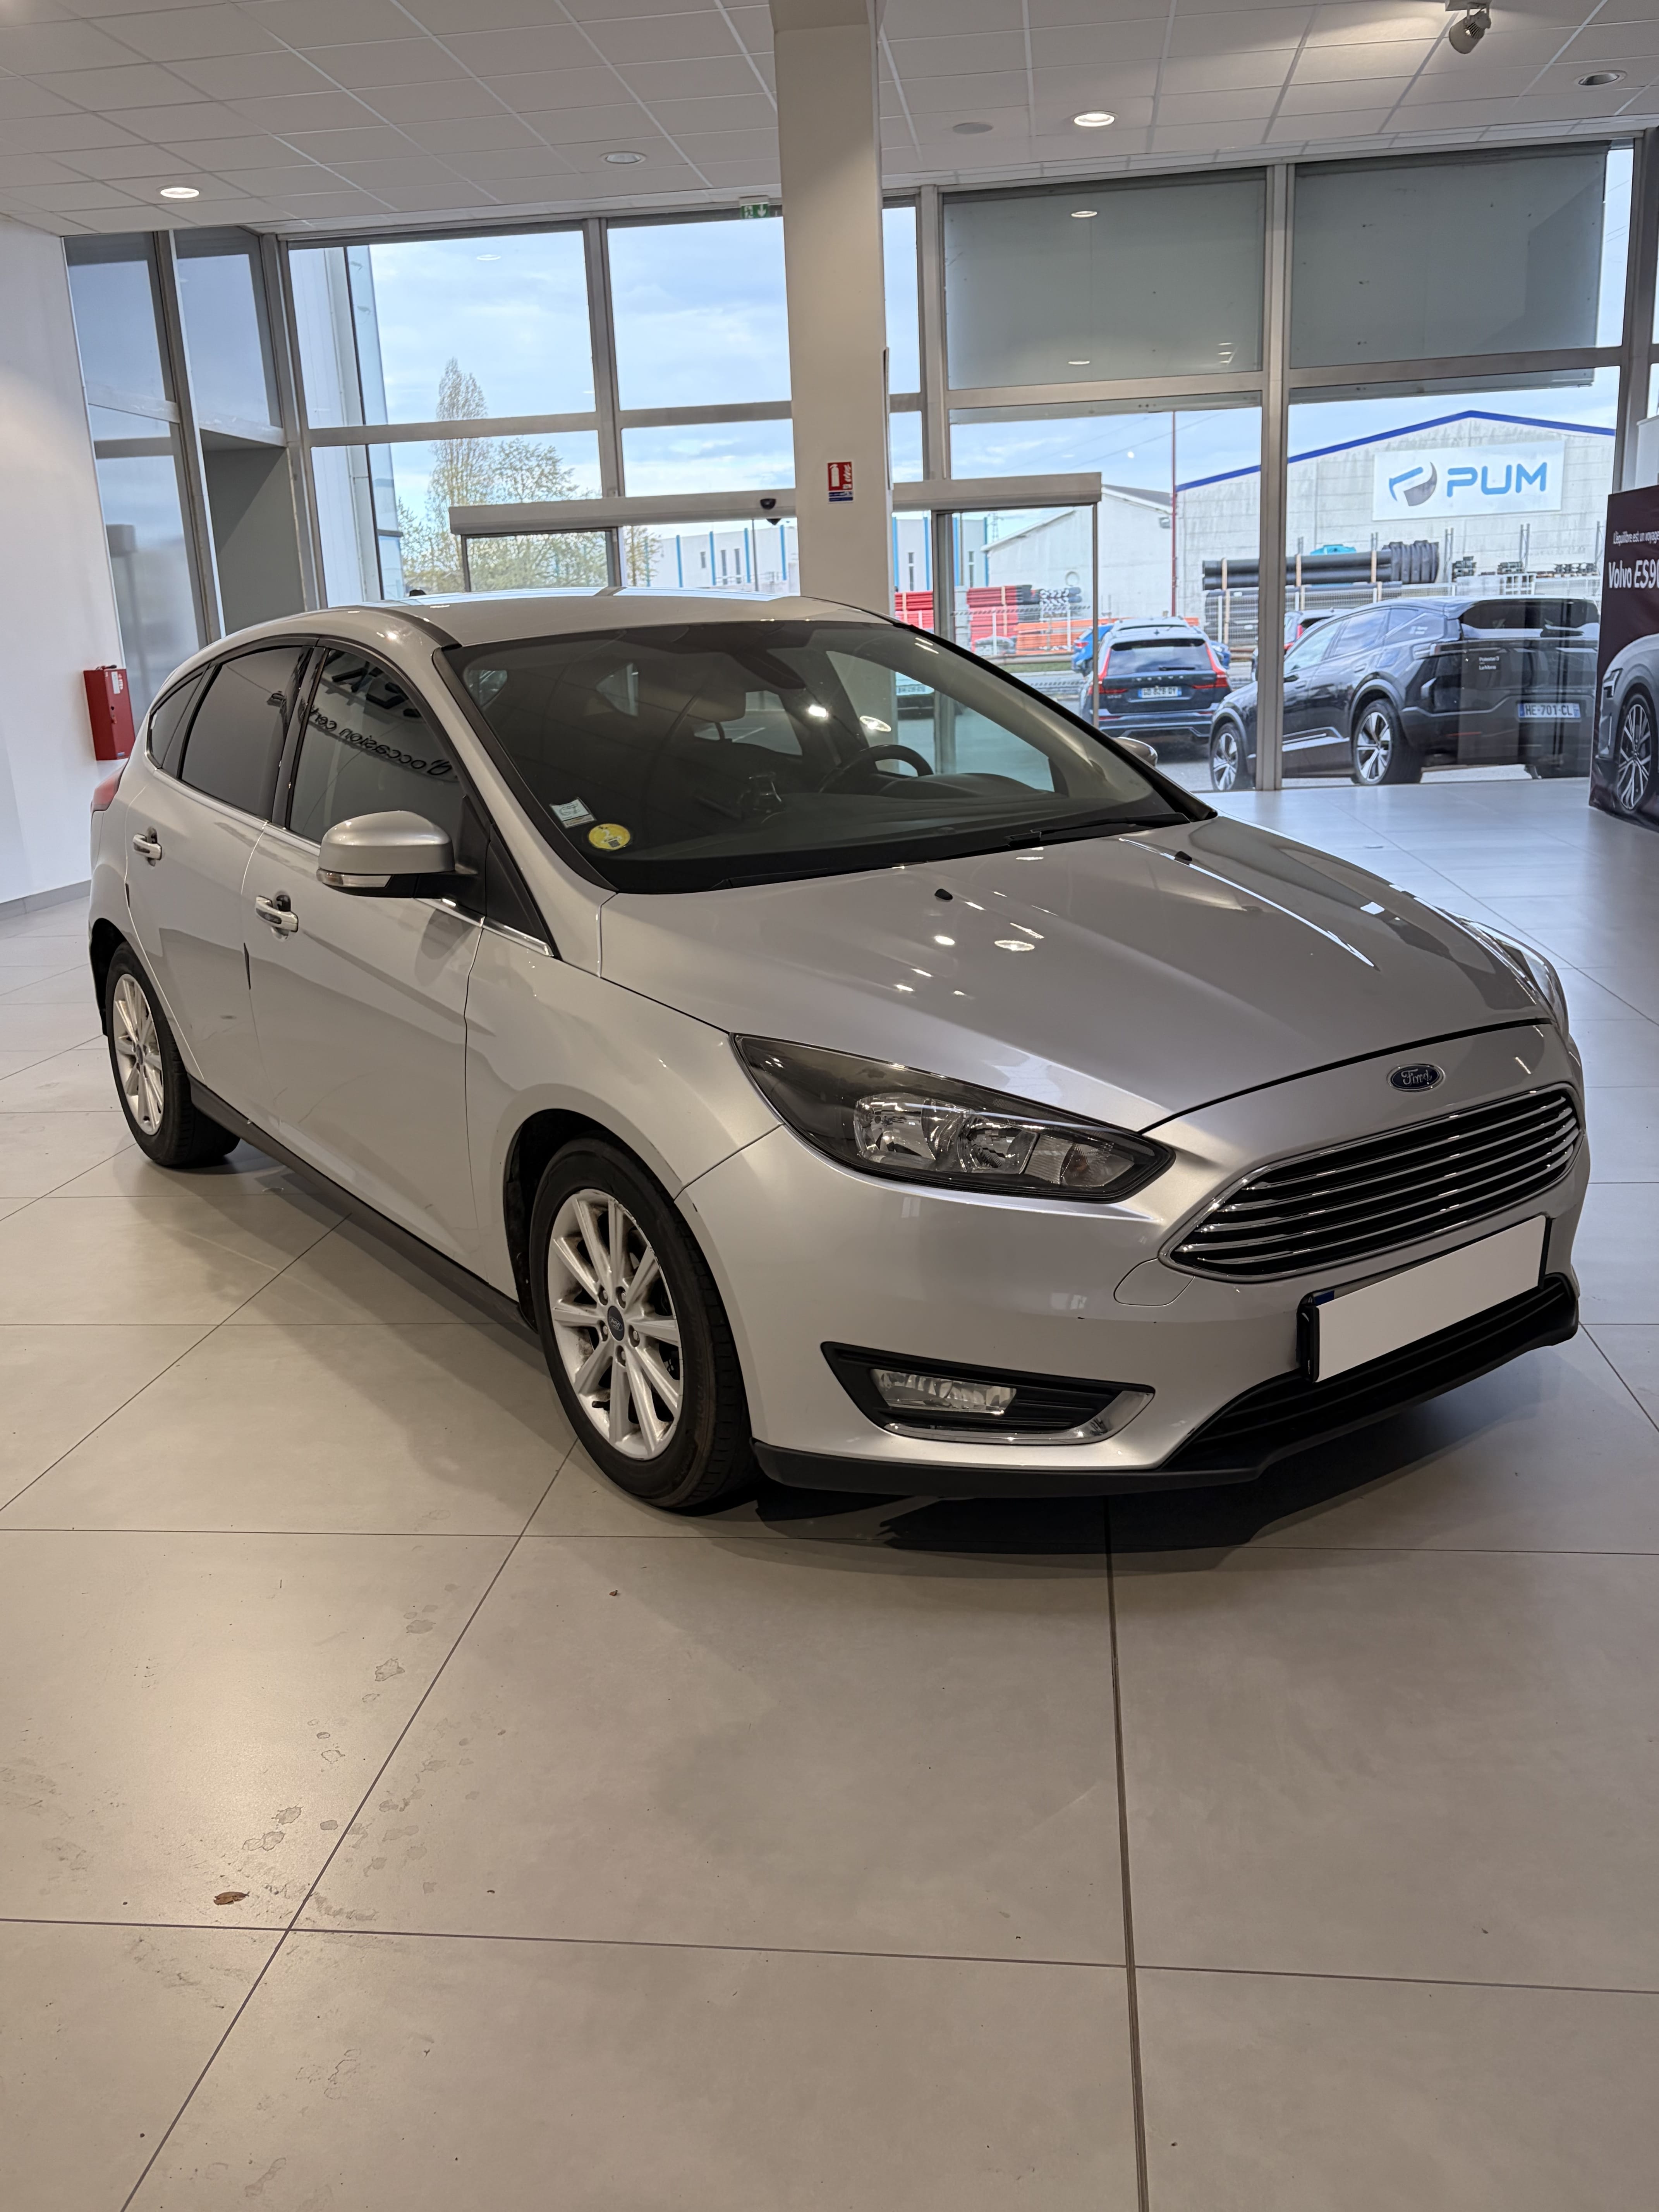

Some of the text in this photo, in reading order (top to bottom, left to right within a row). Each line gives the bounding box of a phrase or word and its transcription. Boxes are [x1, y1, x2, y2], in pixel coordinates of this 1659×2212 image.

[1446, 462, 1547, 498] PUM
[1608, 560, 1632, 588] Volvo
[1525, 705, 1573, 716] HE-701-CL
[1401, 1069, 1432, 1085] Ford
